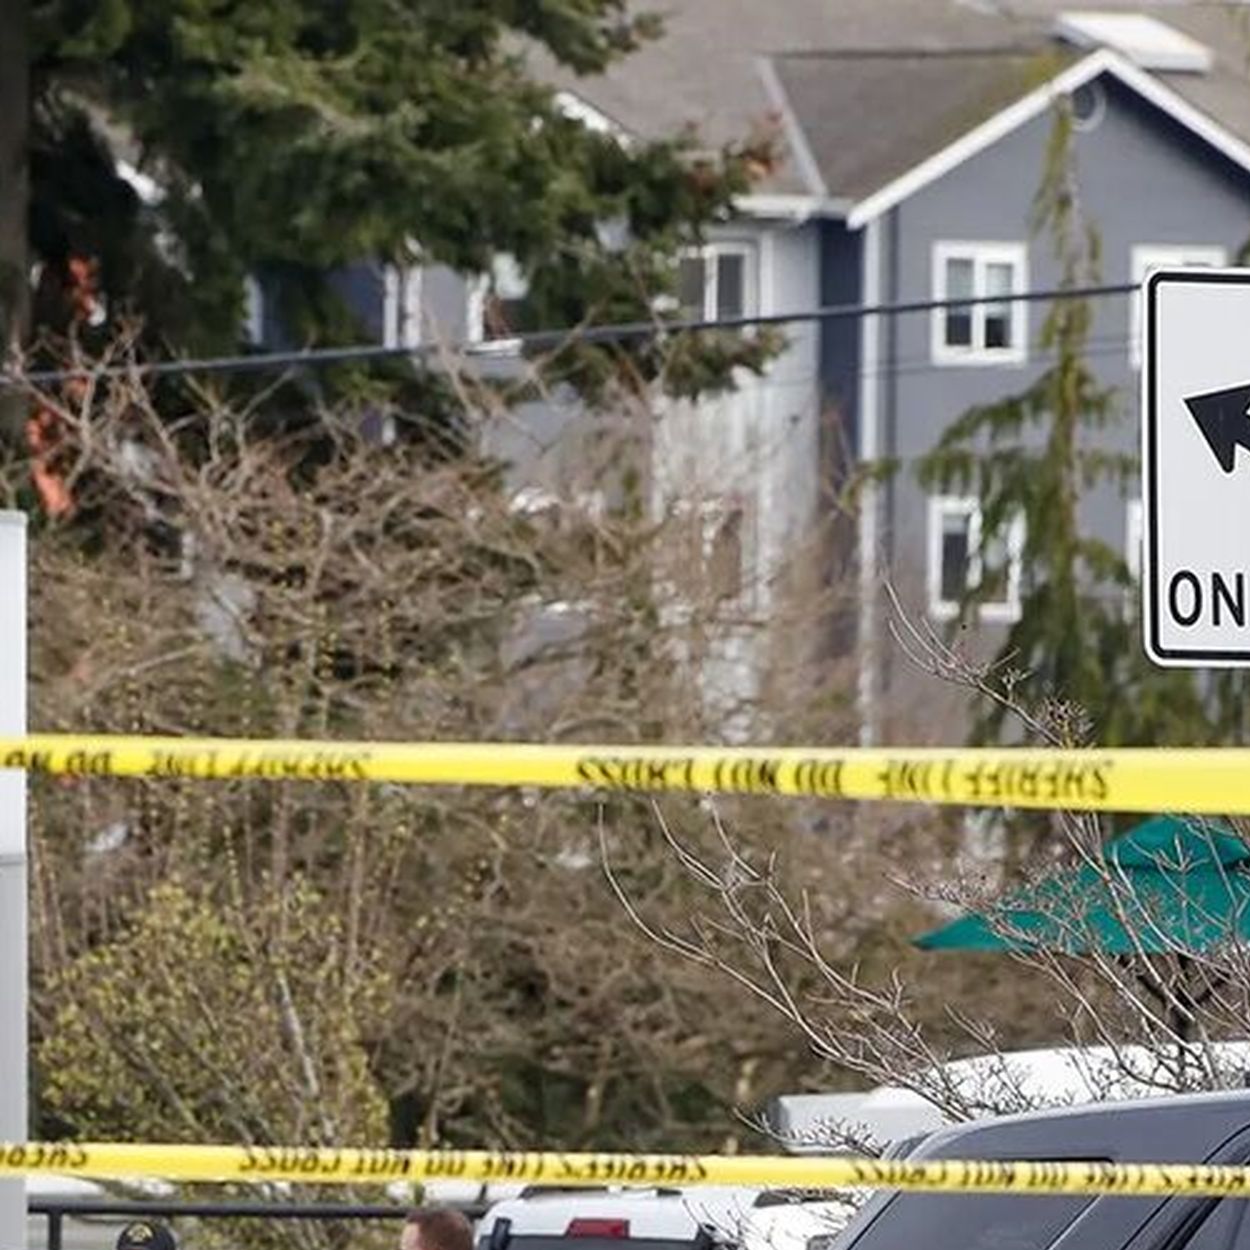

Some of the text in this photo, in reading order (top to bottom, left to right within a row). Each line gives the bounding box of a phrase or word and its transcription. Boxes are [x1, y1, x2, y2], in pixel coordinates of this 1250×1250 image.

[576, 757, 1113, 800] SHERIFF LINE DO NOT CROSS
